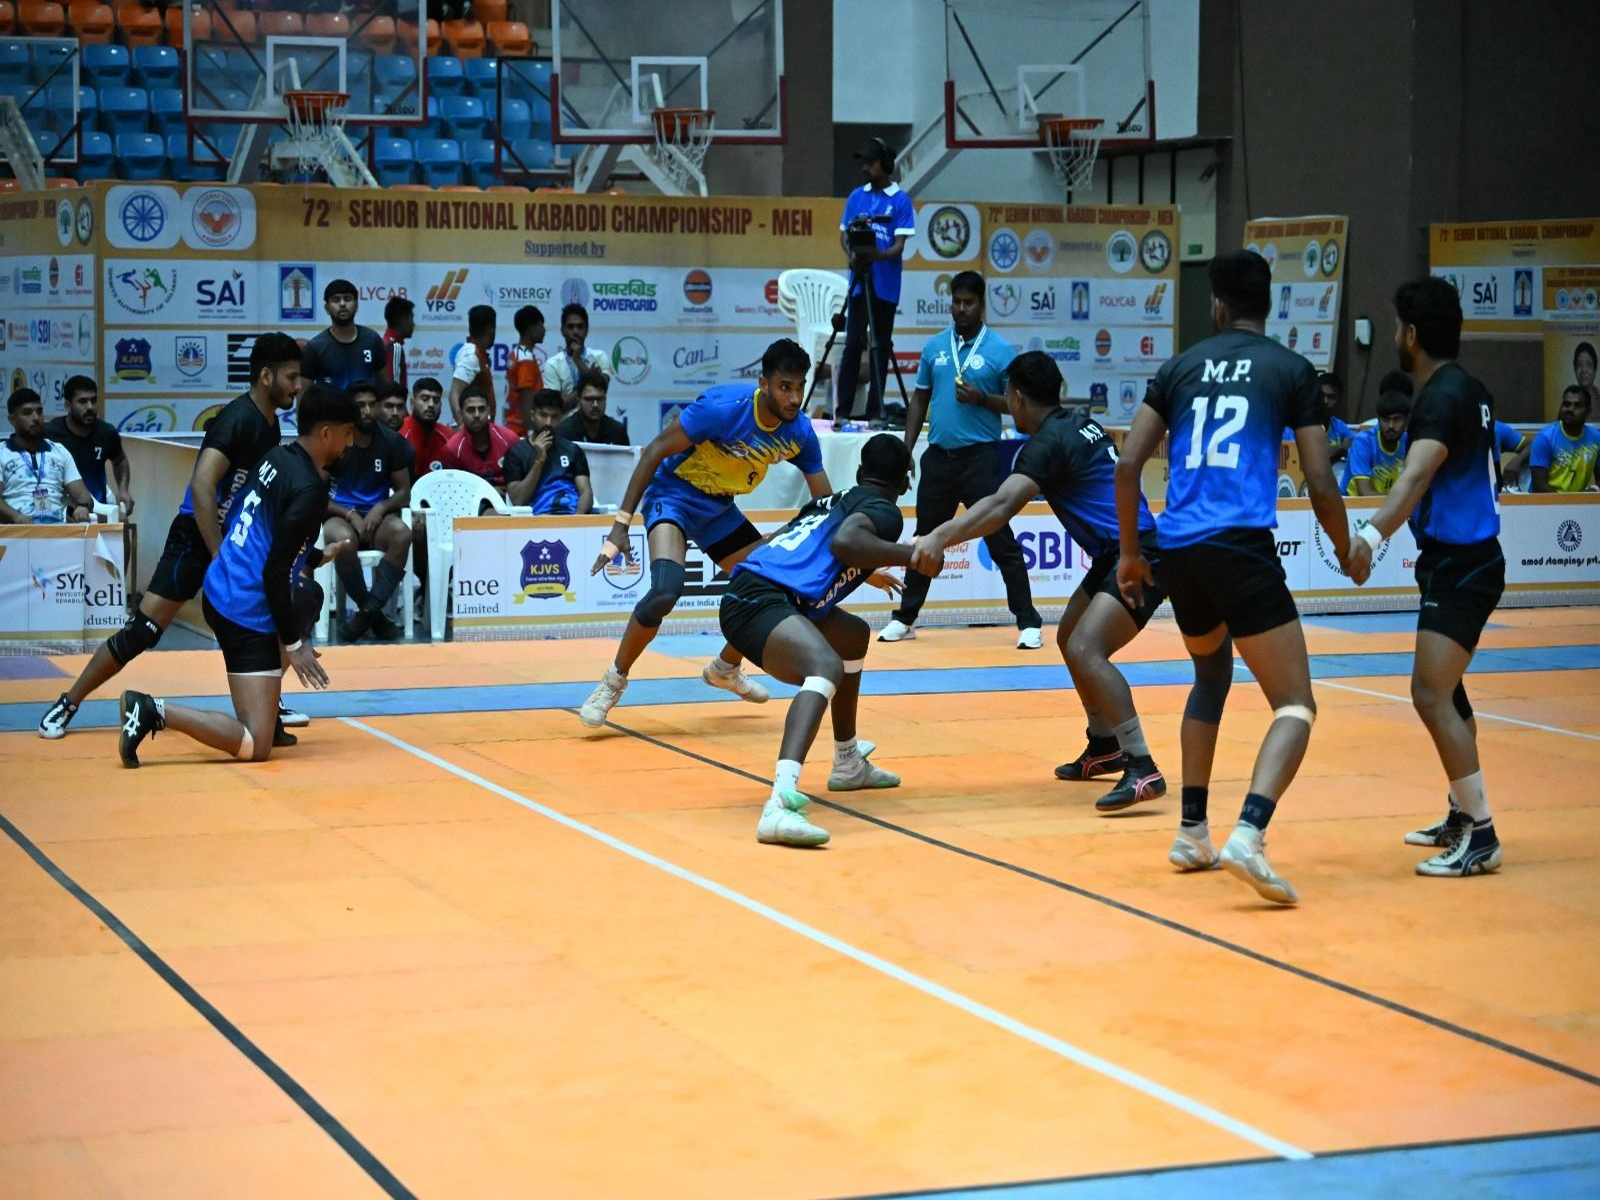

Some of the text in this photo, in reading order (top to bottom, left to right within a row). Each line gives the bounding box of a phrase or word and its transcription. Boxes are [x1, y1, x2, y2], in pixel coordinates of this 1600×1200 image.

[350, 199, 419, 228] SENIOR
[425, 200, 518, 231] NATIONAL
[524, 203, 606, 232] KABADDI
[611, 205, 752, 235] CHAMPIONSHIP
[772, 209, 812, 236] MEN
[525, 240, 605, 257] Supported by
[196, 280, 245, 306] SAI
[357, 286, 407, 301] LYCAB
[499, 287, 552, 300] SYNERGY
[592, 279, 657, 297] पावरग्रिड
[1473, 282, 1498, 304] SAI
[426, 301, 456, 313] YPG
[593, 298, 657, 312] POWERGRID
[1031, 290, 1055, 311] SAI
[1145, 306, 1160, 315] YPG
[363, 350, 372, 363] 3
[1201, 359, 1252, 383] M.P.
[1185, 395, 1249, 469] 12
[95, 447, 102, 460] 7
[375, 459, 382, 473] 9
[1570, 469, 1577, 485] 7
[655, 502, 663, 516] 9
[1016, 531, 1072, 570] SBI
[944, 558, 971, 570] aroda
[1521, 556, 1543, 566] amod
[1587, 555, 1600, 566] pvt.
[531, 564, 560, 575] KJVS
[459, 578, 499, 597] nce
[456, 603, 499, 614] Limited
[84, 614, 126, 626] dustri
